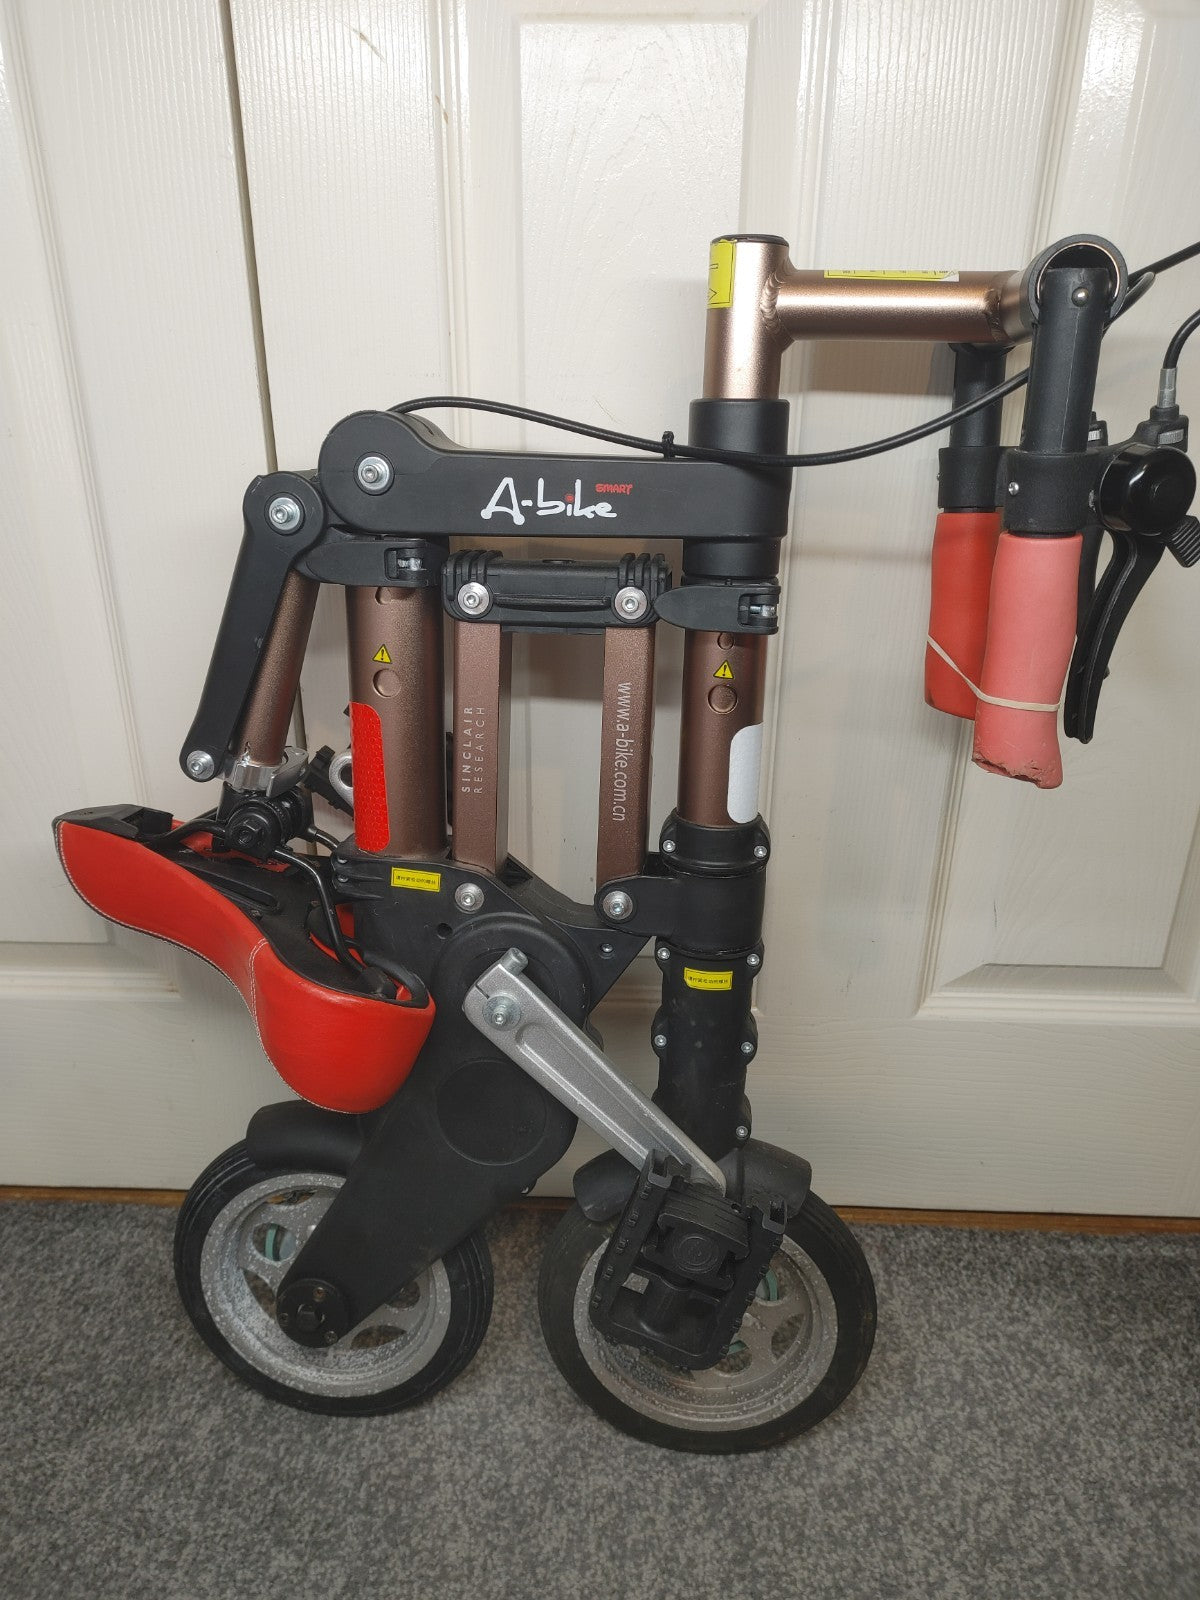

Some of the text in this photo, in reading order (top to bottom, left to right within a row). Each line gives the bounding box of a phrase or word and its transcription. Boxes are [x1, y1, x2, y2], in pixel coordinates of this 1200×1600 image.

[480, 476, 618, 526] A-bike
[595, 483, 634, 495] SMART
[461, 707, 473, 793] SINCLAIR
[473, 707, 485, 794] RESEARCH
[612, 682, 635, 822] www.a-bike.com.cn
